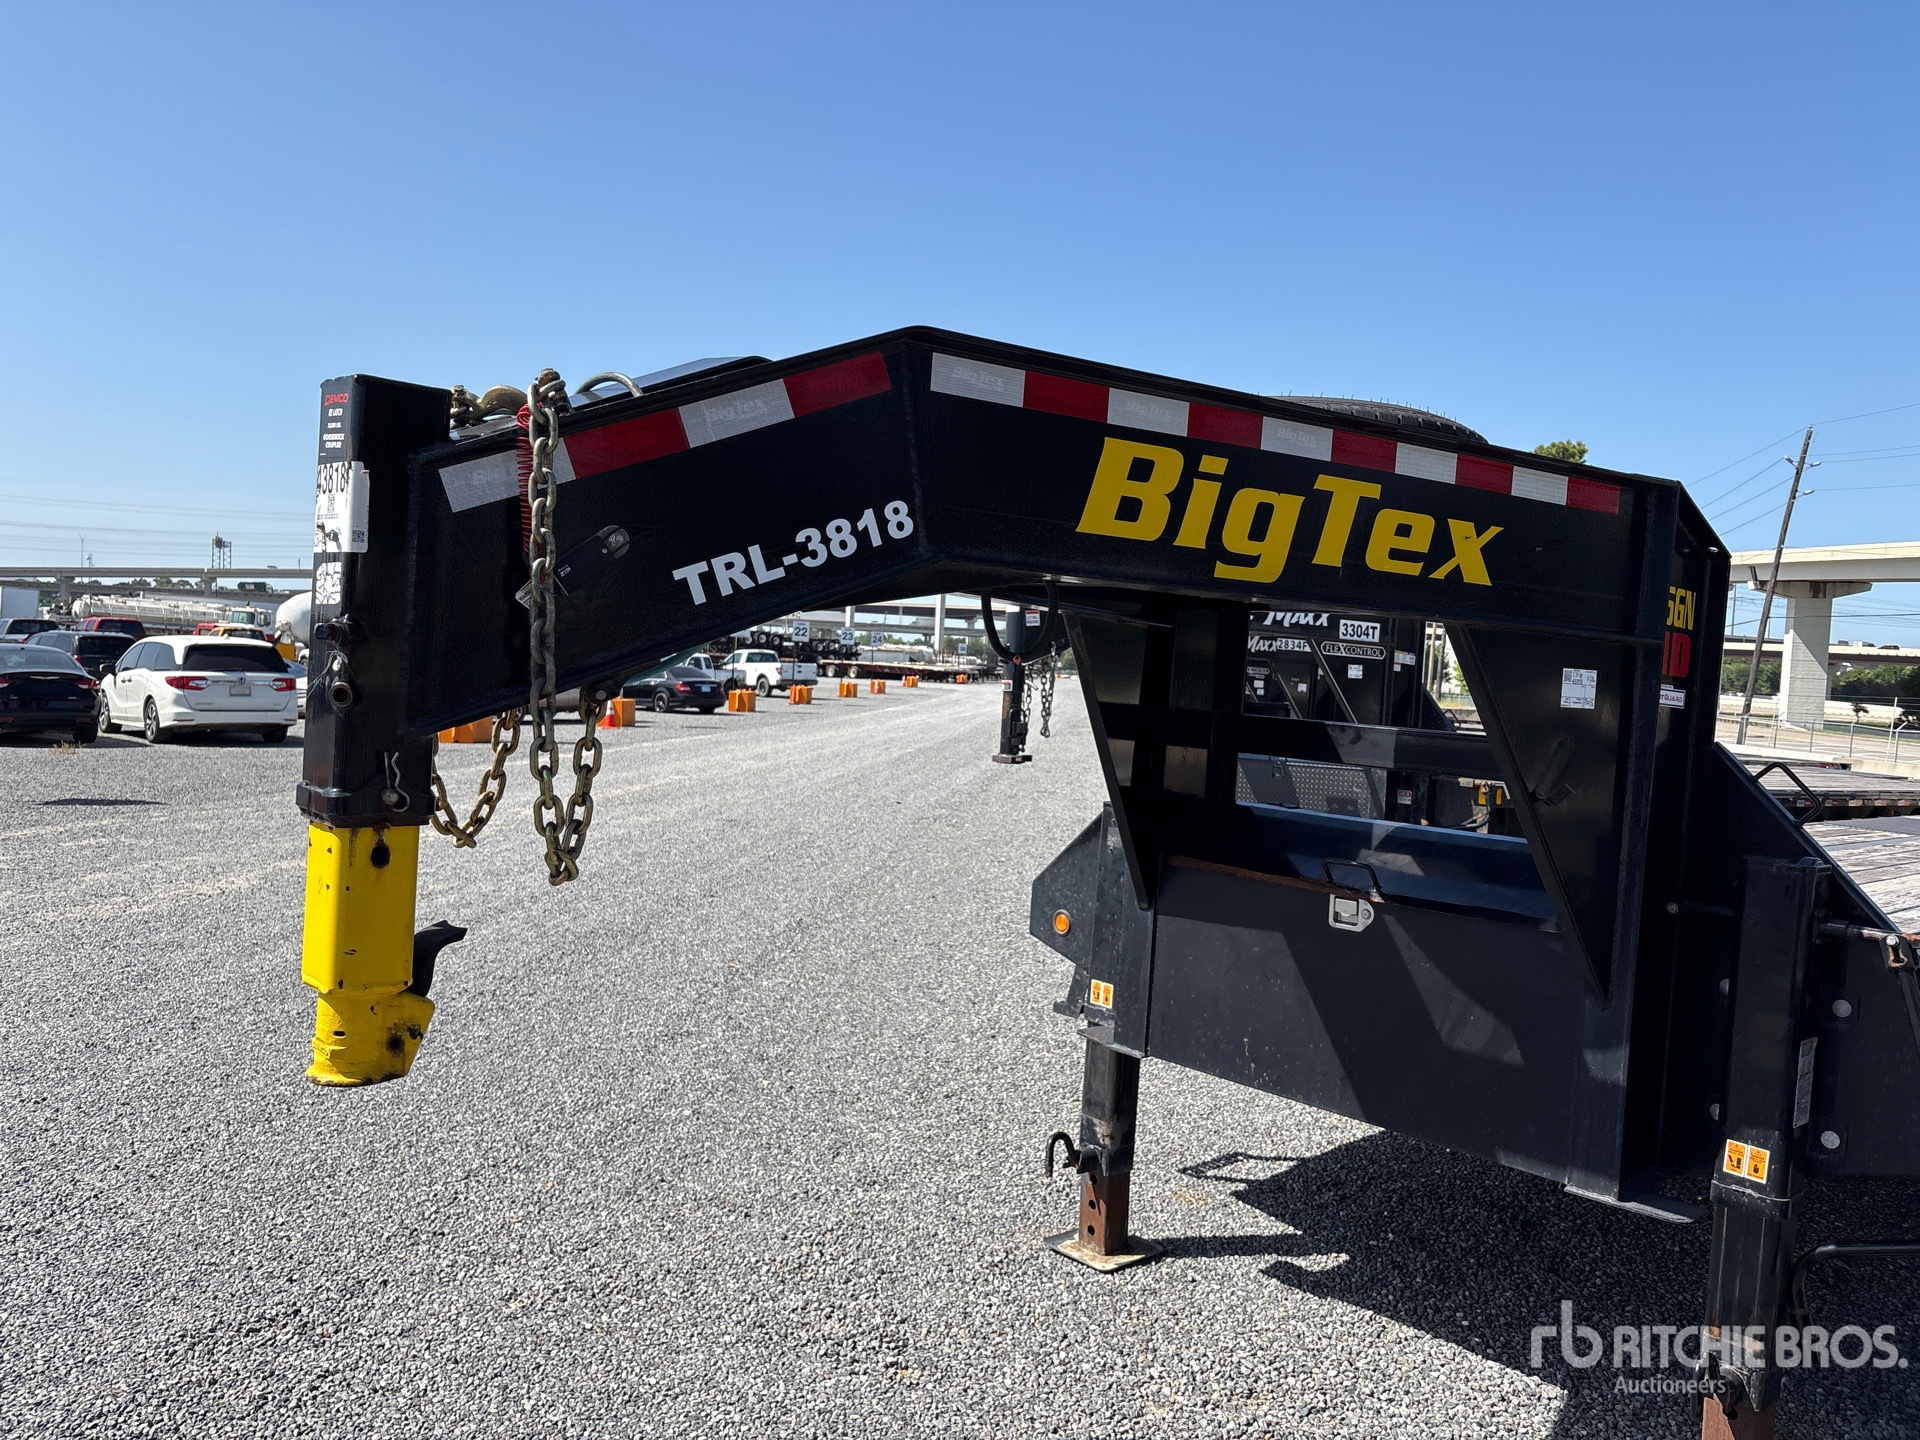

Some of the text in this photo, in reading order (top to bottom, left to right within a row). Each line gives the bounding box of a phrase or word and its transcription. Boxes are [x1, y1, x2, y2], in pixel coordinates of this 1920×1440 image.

[1075, 436, 1504, 587] BigTex
[672, 500, 914, 606] TRL-3818
[794, 626, 808, 638] 22
[842, 632, 854, 641] 23
[1341, 622, 1378, 640] 3304T
[872, 635, 882, 644] 24
